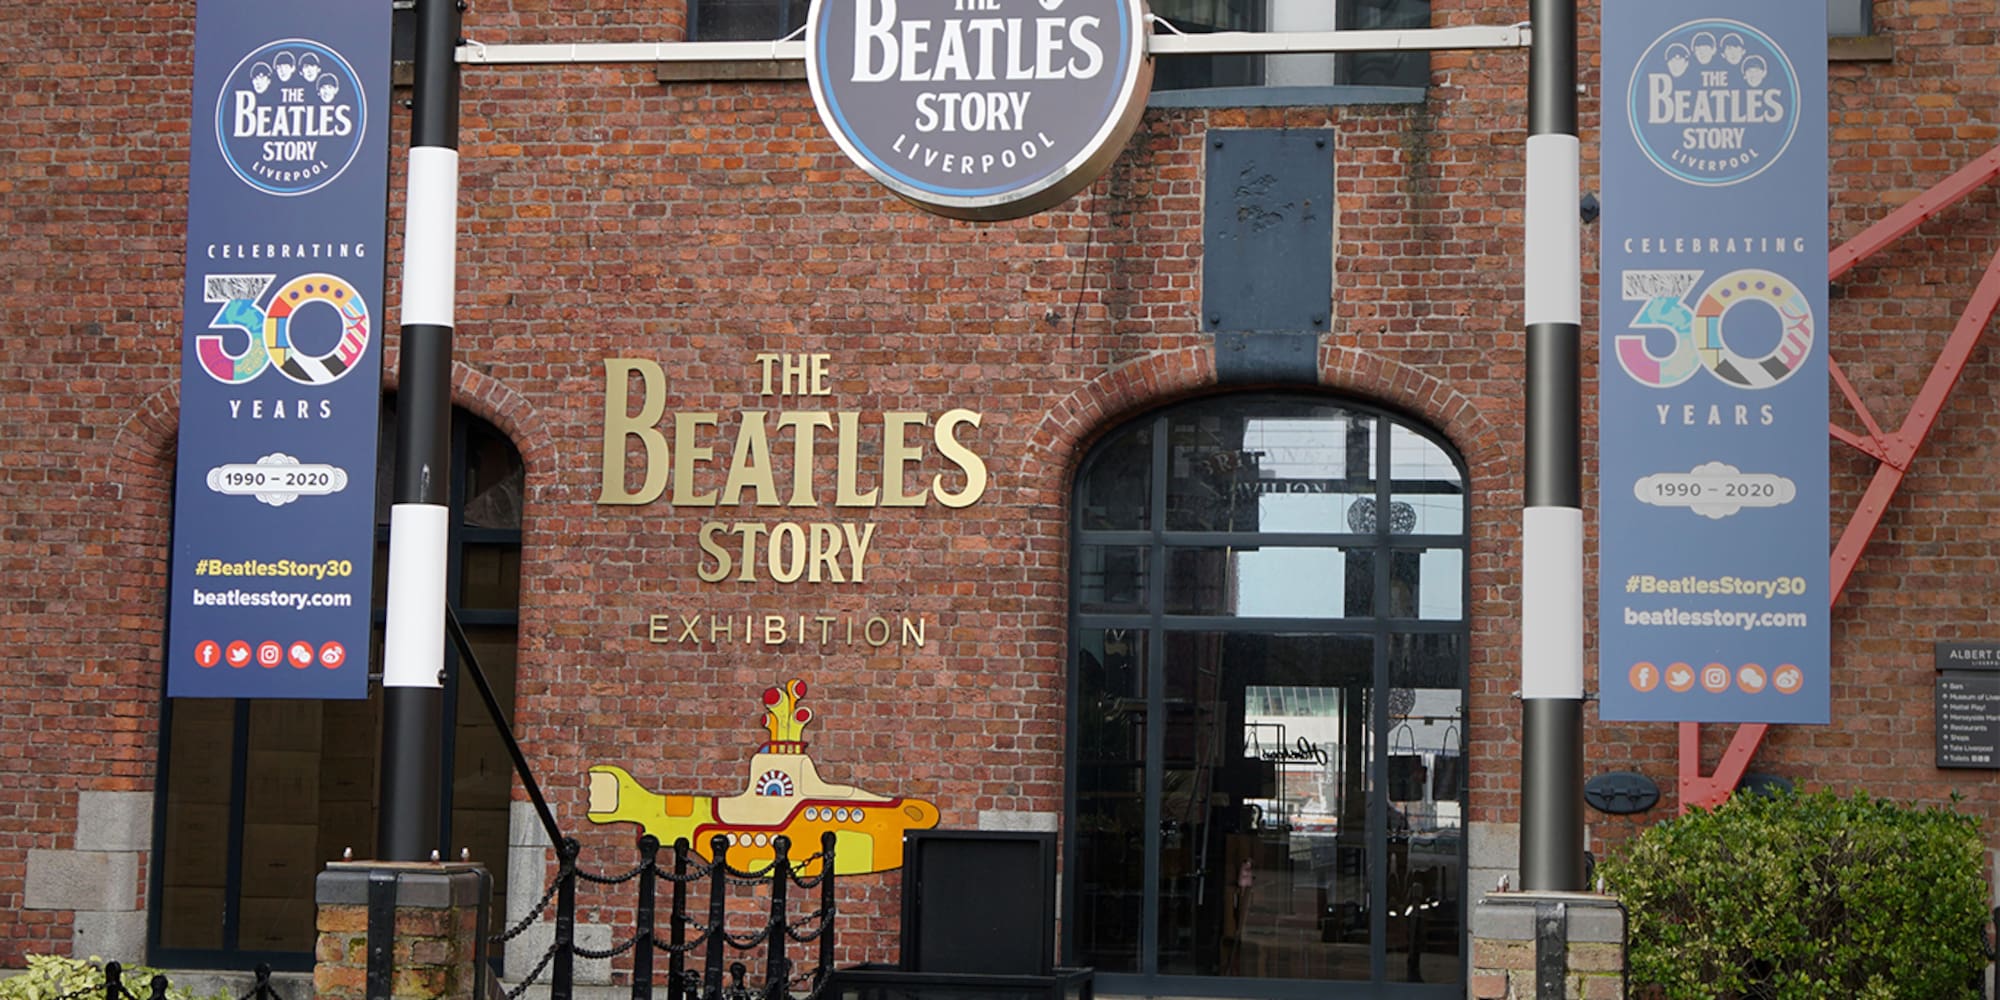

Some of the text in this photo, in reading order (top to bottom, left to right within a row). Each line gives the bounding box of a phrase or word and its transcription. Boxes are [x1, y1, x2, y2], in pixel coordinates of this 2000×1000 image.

[850, 0, 1103, 83] BEATLES
[1701, 71, 1728, 87] THE
[281, 88, 304, 103] THE
[1648, 72, 1784, 125] BEATLES
[233, 90, 352, 138] BEATLES
[915, 91, 1031, 132] STORY
[1683, 128, 1745, 150] STORY
[263, 141, 318, 161] STORY
[892, 131, 1055, 175] LIVERPOOL
[1671, 148, 1760, 172] LIVERPOOL
[252, 160, 329, 182] LIVERPOOL
[207, 243, 366, 259] CELEBRATING
[1624, 237, 1805, 254] CELEBRATING
[196, 273, 370, 385] 30
[1615, 268, 1815, 390] 30
[755, 353, 833, 396] THE
[229, 400, 332, 419] YEARS
[1657, 405, 1774, 426] YEARS
[597, 357, 988, 509] BEATLES
[225, 473, 266, 486] 1990
[285, 473, 329, 486] 2020
[1655, 483, 1702, 497] 1990
[1725, 483, 1774, 497] 2020
[697, 522, 876, 583] STORY
[195, 559, 352, 580] #BeatlesStory30
[1625, 576, 1806, 599] #BeatlesStory30
[193, 589, 352, 610] beatlesstory.com
[1624, 607, 1807, 631] beatlesstory.com
[649, 614, 927, 648] EXHIBITION
[1949, 649, 1993, 660] ALBERT
